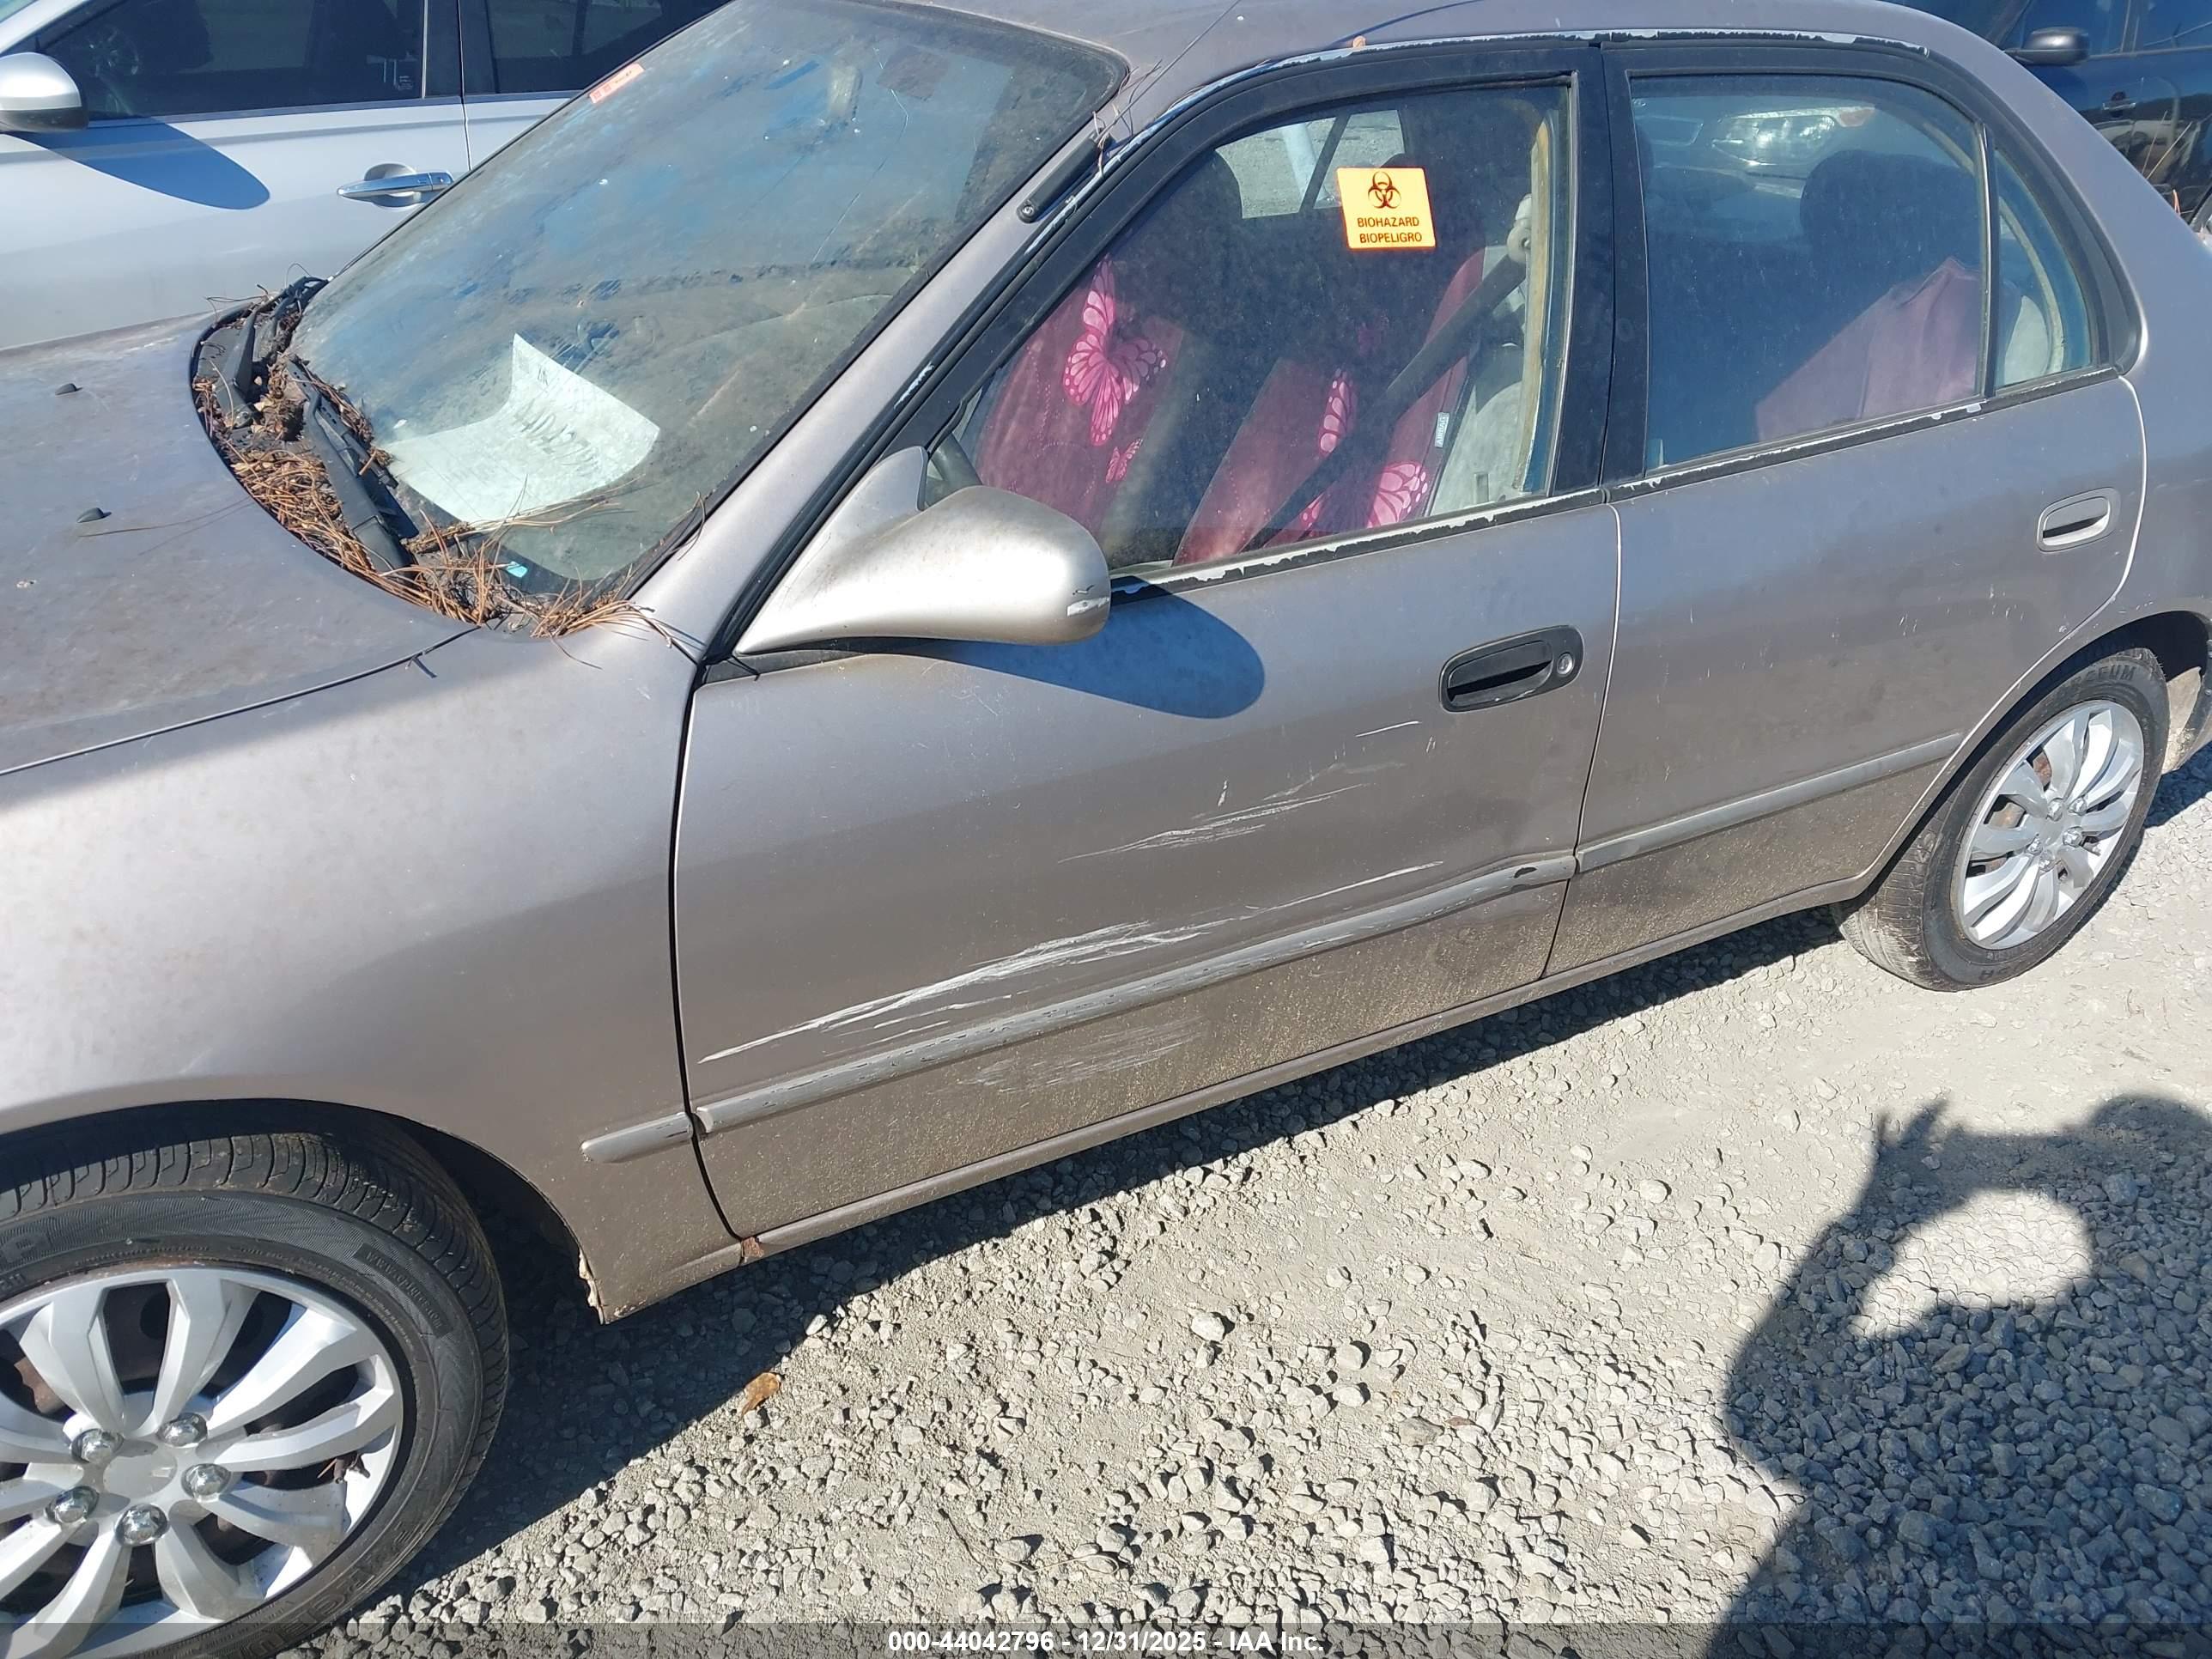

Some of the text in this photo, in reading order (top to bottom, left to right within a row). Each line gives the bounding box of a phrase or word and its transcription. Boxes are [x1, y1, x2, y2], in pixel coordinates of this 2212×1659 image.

[1357, 217, 1419, 228] BIOHAZARD
[1359, 233, 1422, 243] BIOPELIGRO
[1435, 416, 1449, 447] AIRBAG
